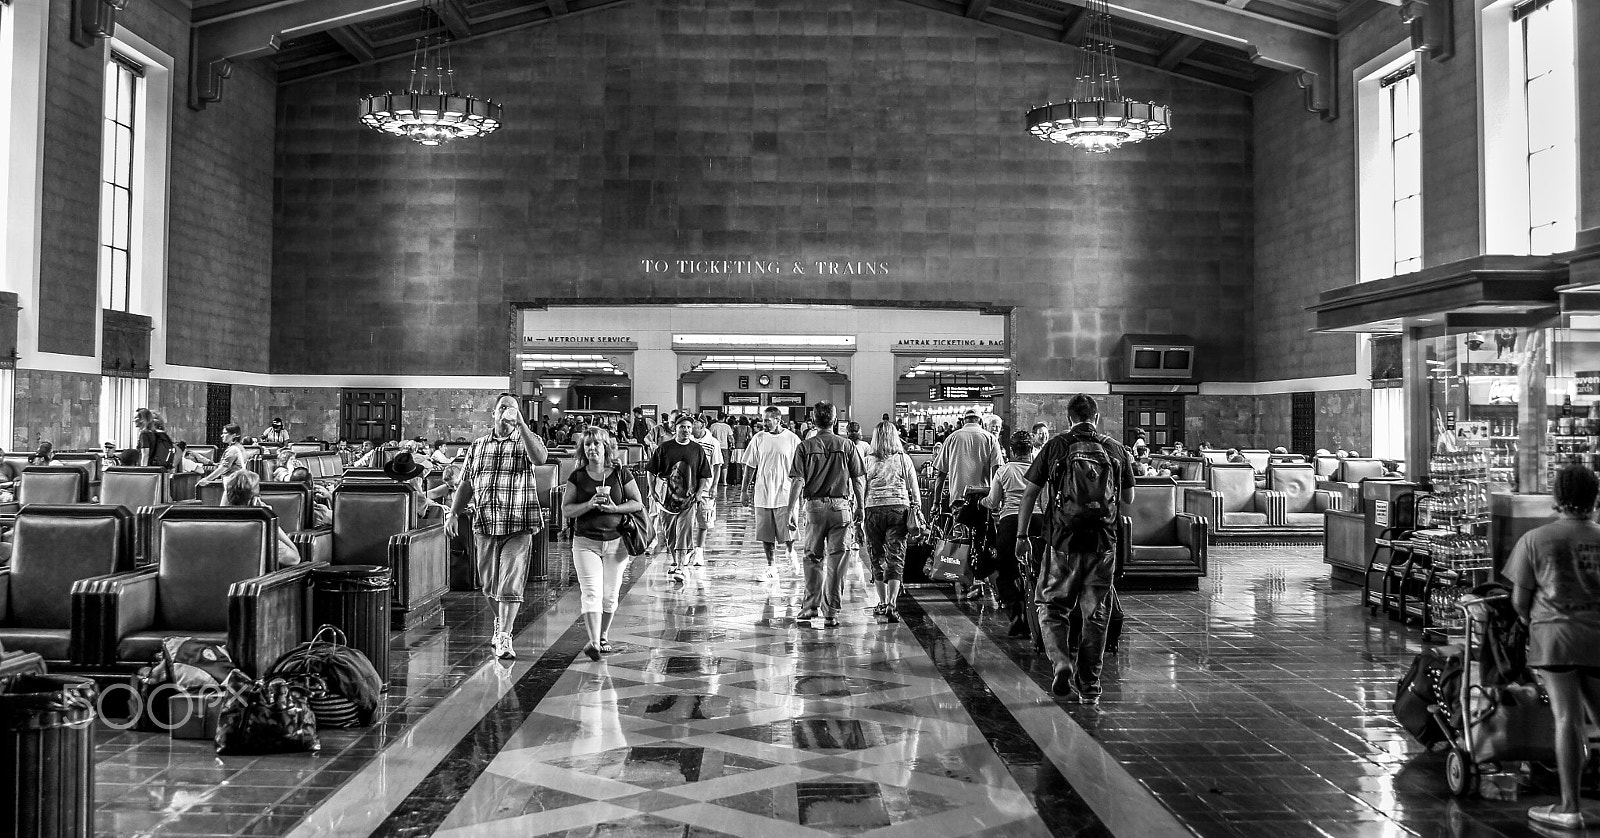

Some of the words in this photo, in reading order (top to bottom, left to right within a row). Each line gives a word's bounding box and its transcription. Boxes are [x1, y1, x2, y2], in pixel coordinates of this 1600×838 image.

[641, 259, 669, 273] TO
[676, 259, 781, 274] TICKETING
[792, 260, 805, 275] &
[815, 260, 889, 275] TRAINS
[547, 335, 595, 343] METROLINK
